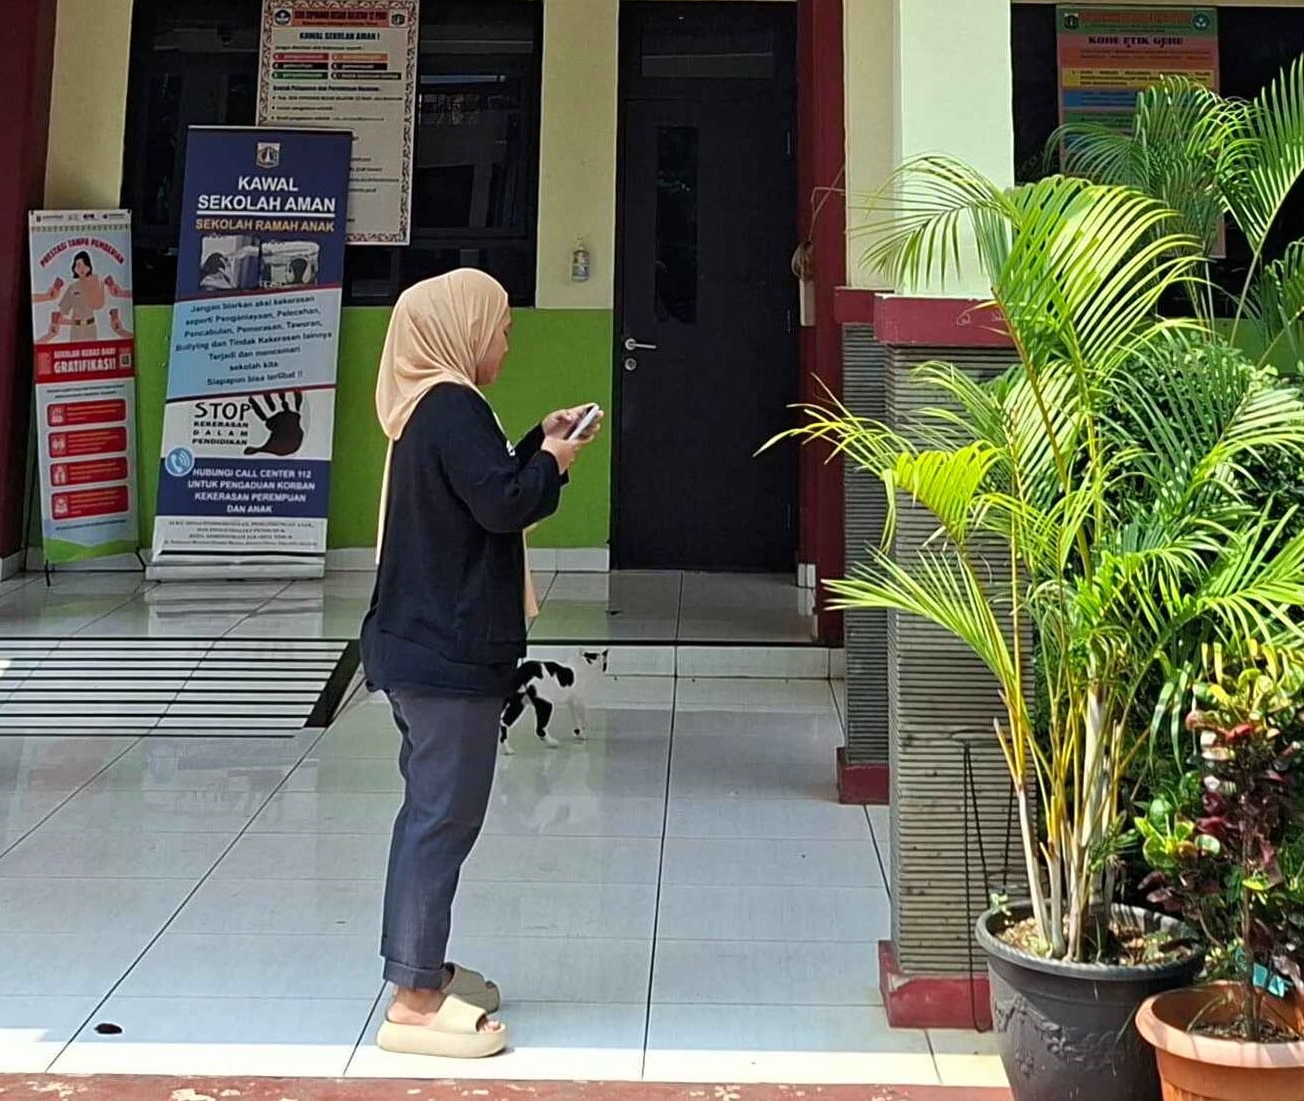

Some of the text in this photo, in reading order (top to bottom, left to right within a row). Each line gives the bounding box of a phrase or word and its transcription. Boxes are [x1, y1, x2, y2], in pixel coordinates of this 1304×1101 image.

[238, 176, 299, 191] KAWAL
[197, 194, 336, 212] SEKOLAH AMAN
[195, 218, 335, 232] SEKOLAH RAMAH ANAK
[273, 297, 315, 305] kekerasan
[211, 340, 226, 348] dan
[258, 334, 301, 344] Kekerasan
[238, 350, 253, 358] dan
[229, 362, 261, 370] sekolah
[195, 402, 251, 421] STOP
[192, 468, 312, 479] HUBUNGI CALL CENTER 112
[188, 480, 316, 491] UNTUK PENGADUAN KORBAN
[195, 492, 307, 502] KEKERASAN PEREMPUAN
[226, 504, 273, 513] DAN ANAK
